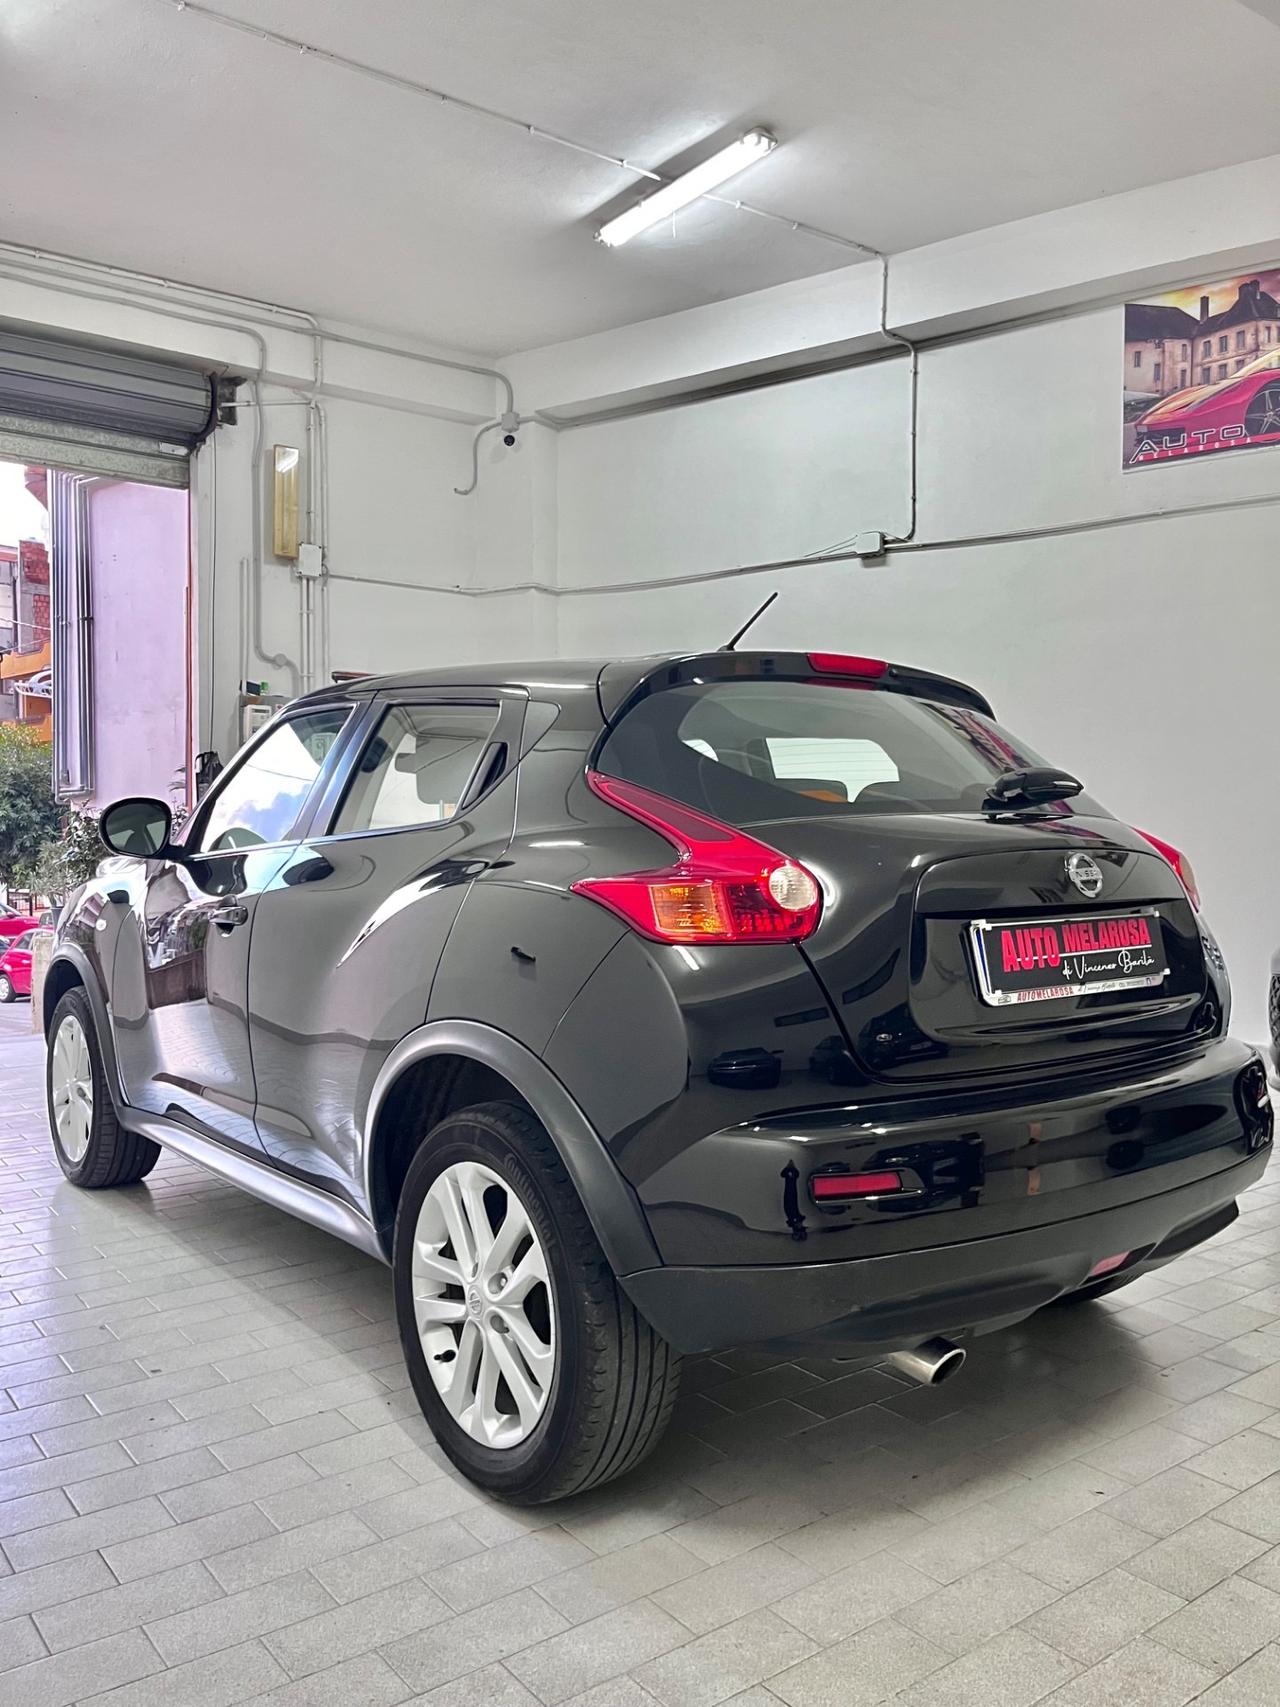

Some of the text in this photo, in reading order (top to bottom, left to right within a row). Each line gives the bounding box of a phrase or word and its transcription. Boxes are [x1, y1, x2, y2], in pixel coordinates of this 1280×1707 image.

[1129, 425, 1245, 464] AUTO
[1001, 919, 1151, 972] AUTO MELAROSA
[1062, 960, 1073, 980] di
[1017, 987, 1074, 1002] AUTOMELAROSA
